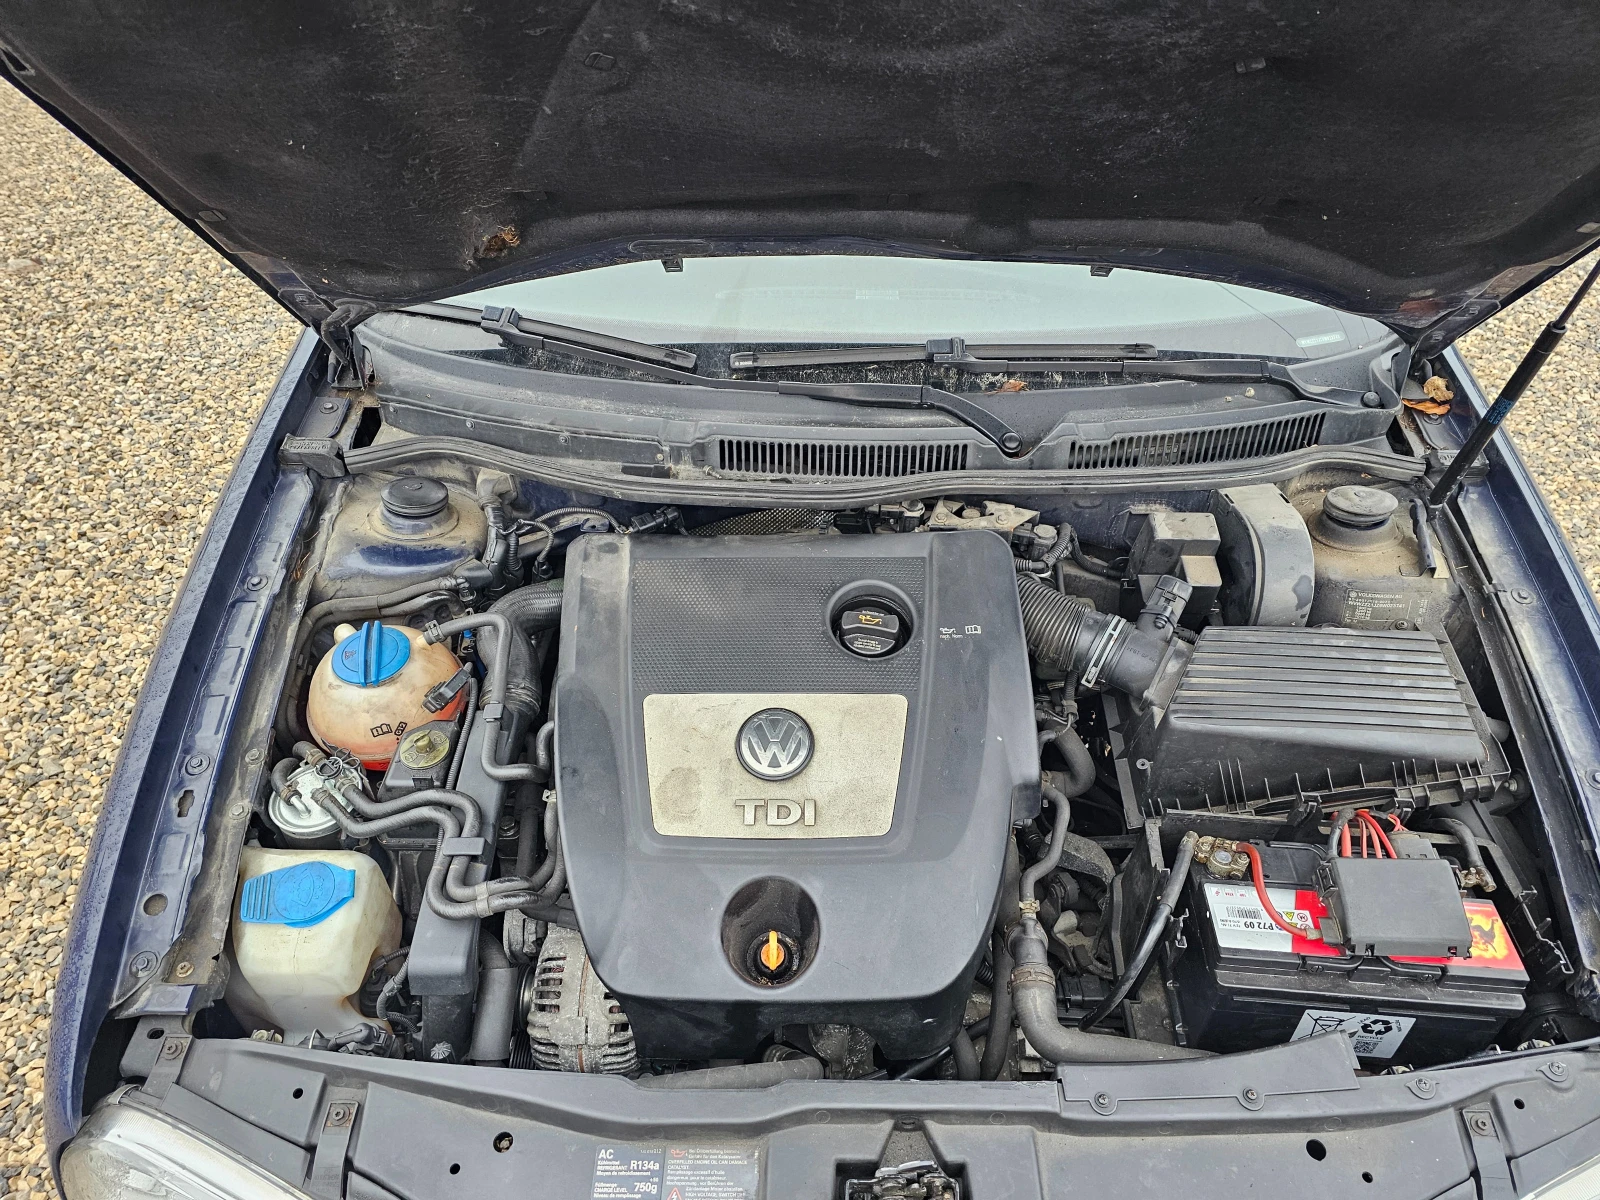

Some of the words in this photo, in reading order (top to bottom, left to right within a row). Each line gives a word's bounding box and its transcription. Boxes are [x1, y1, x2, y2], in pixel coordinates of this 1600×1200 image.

[396, 723, 406, 735] G12
[739, 714, 812, 774] VW
[736, 798, 816, 826] TDI
[1244, 920, 1254, 929] 09
[1256, 922, 1274, 930] P72
[598, 1149, 614, 1159] AC
[630, 1160, 660, 1170] R134a
[634, 1182, 658, 1194] 750g
